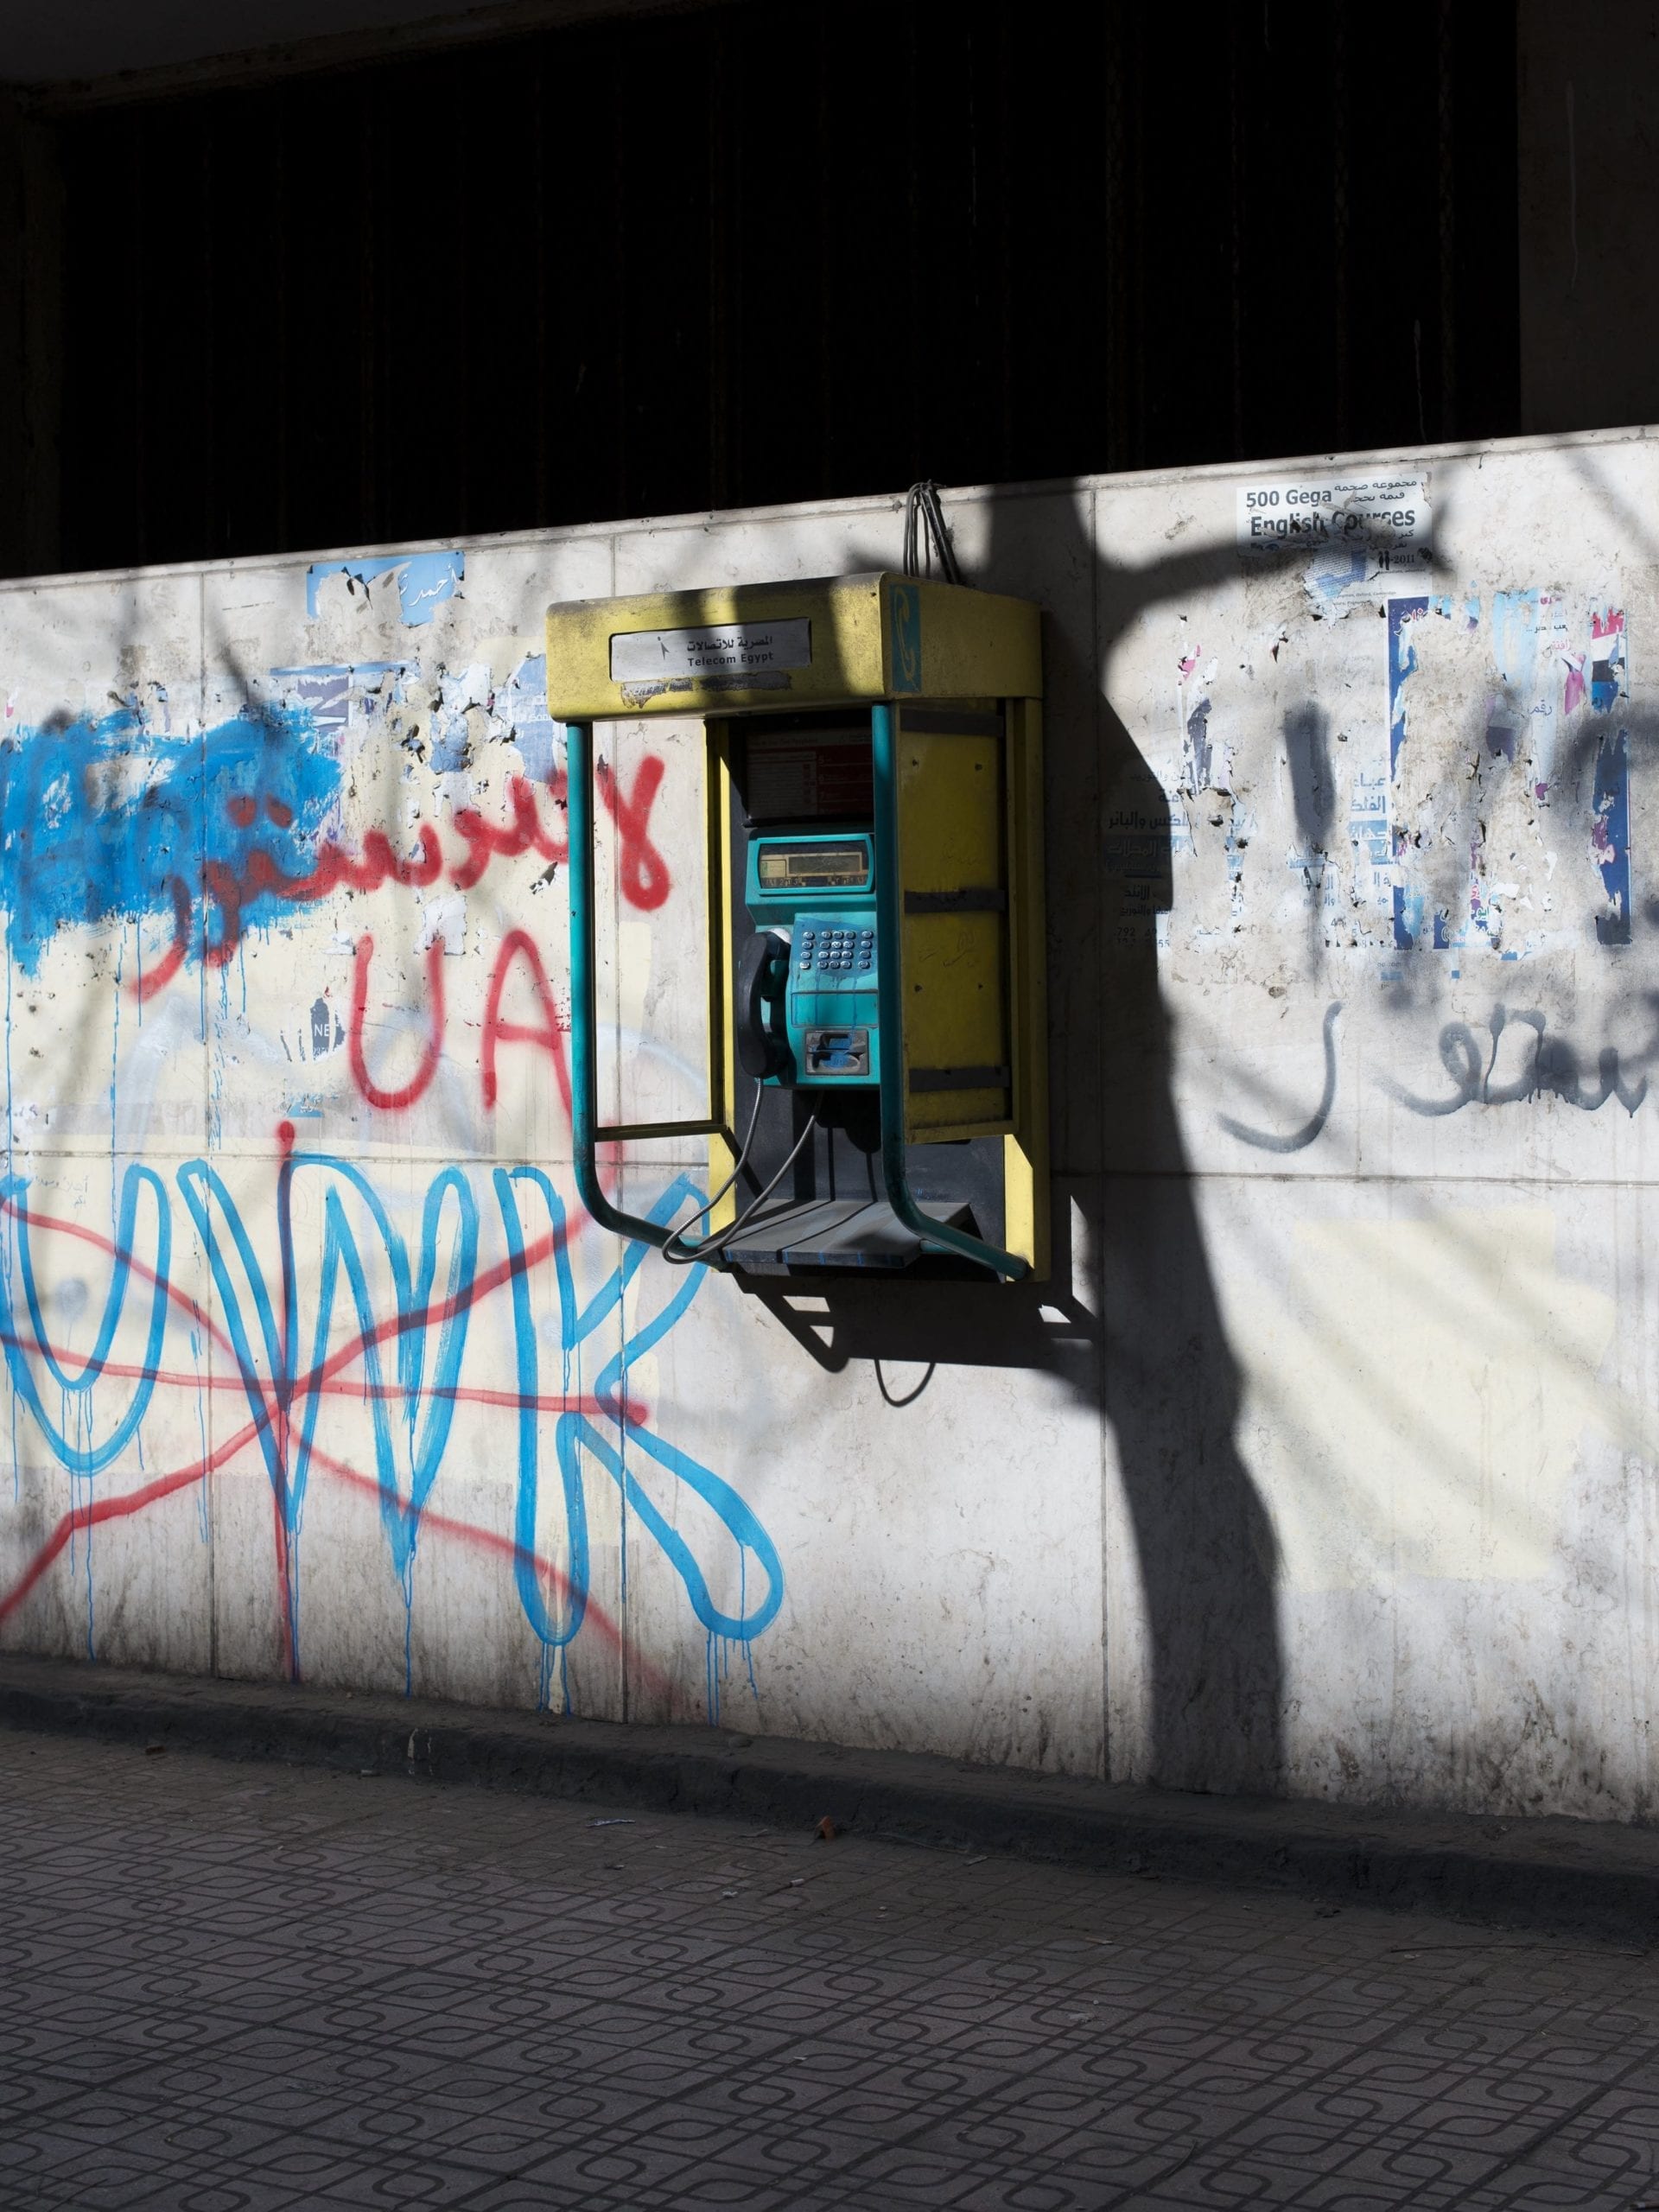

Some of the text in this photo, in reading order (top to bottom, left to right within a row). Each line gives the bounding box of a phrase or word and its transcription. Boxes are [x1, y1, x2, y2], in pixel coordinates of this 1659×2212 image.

[1246, 489, 1332, 508] 500 Gega
[686, 636, 772, 652] المصرية للاتصالات
[688, 652, 774, 666] Telecom Egypt
